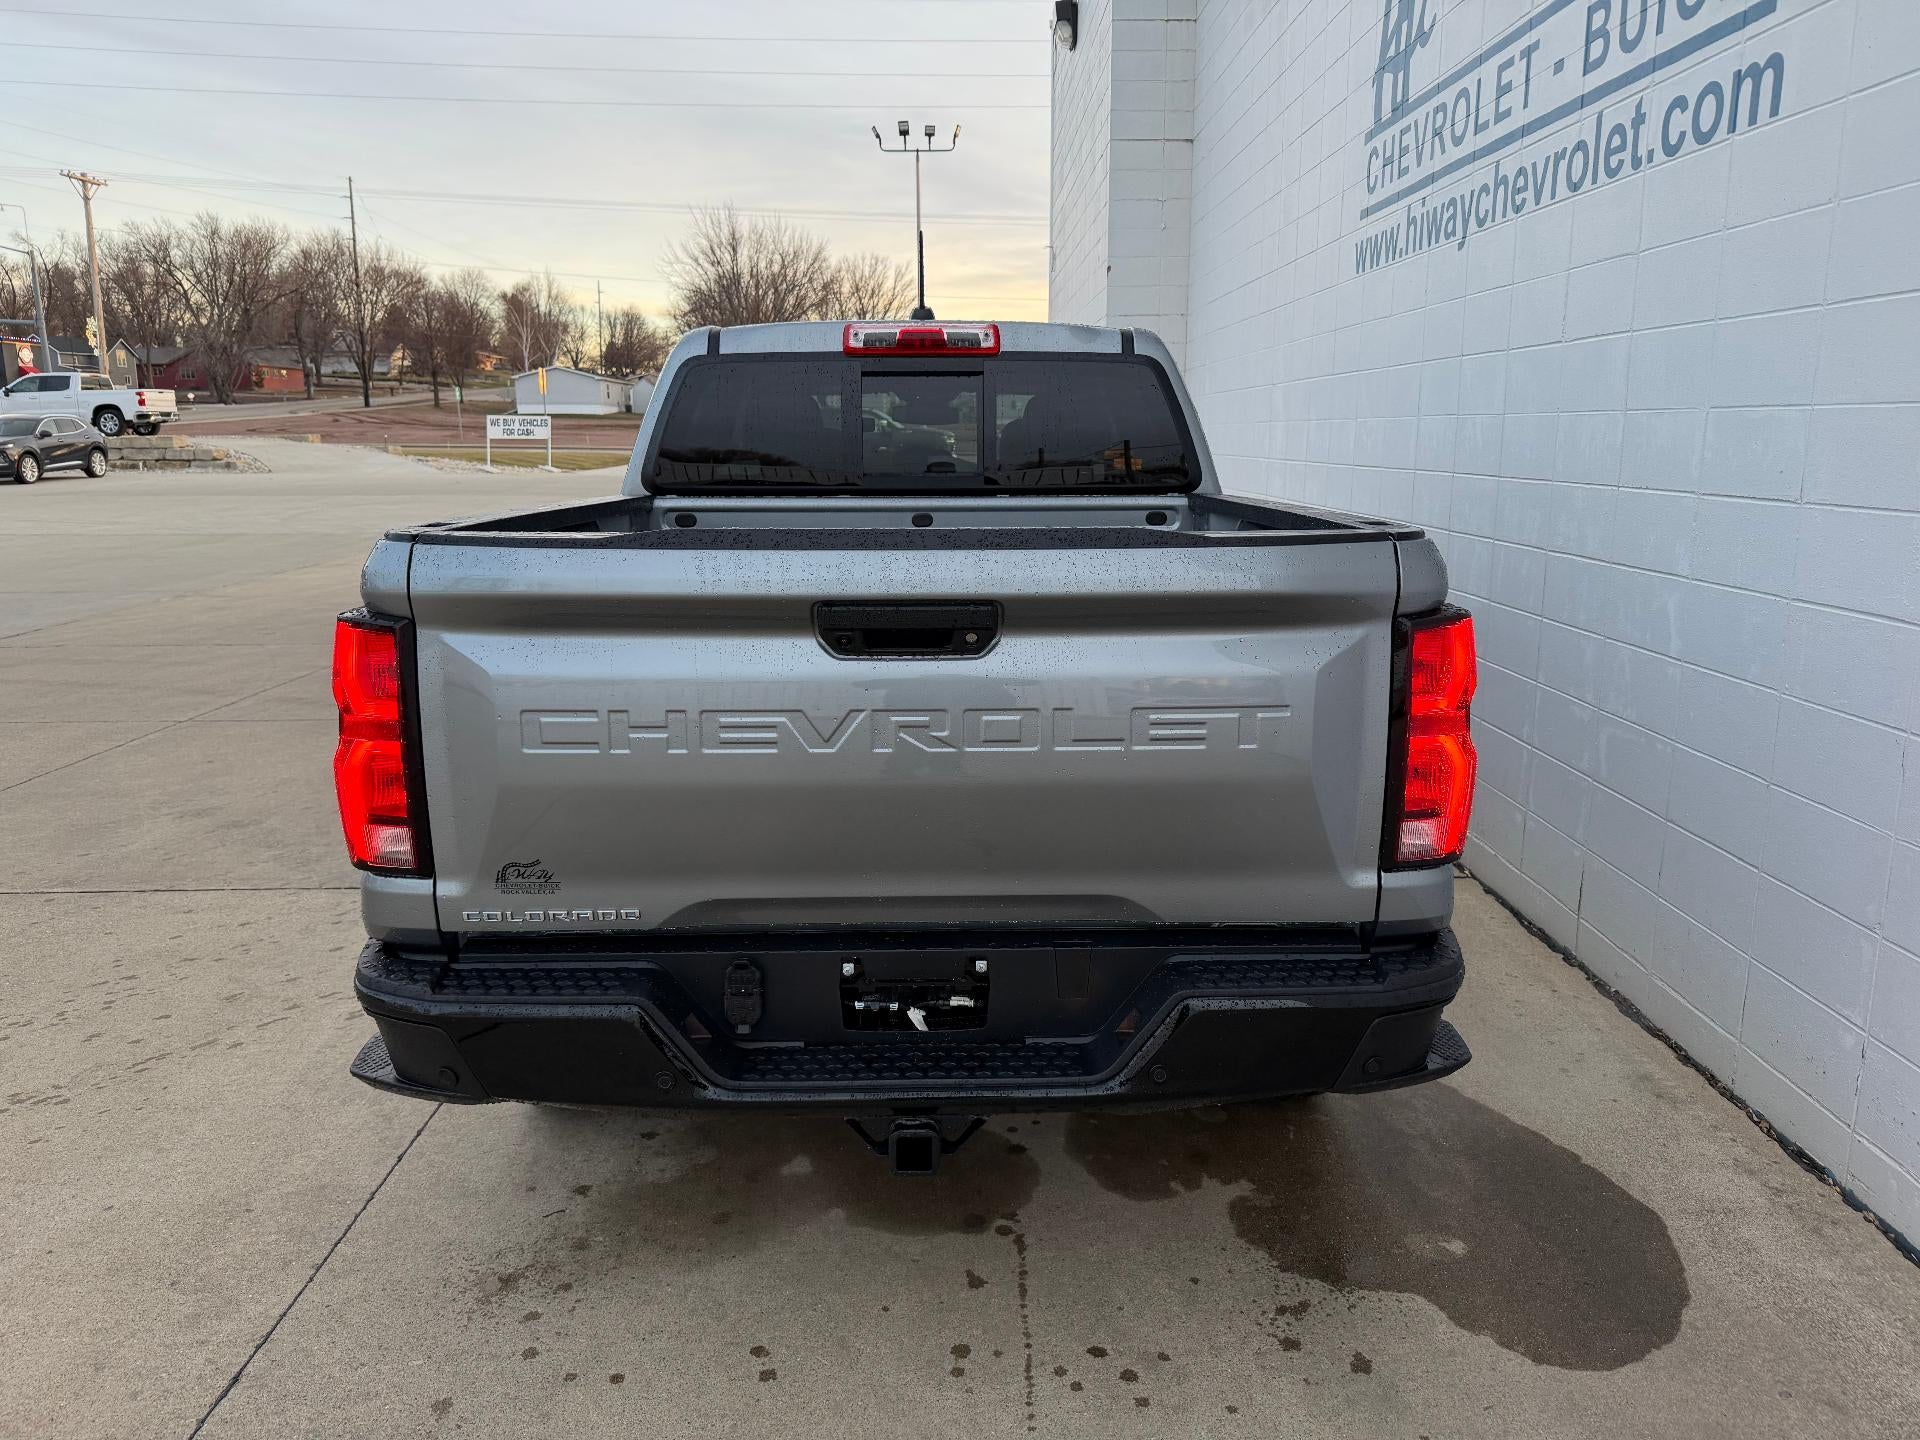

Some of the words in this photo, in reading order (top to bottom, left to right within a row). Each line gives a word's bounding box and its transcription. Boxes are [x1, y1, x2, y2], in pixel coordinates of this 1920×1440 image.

[1366, 39, 1540, 195] CHEVROLET
[1355, 51, 1785, 275] www.hiwaychevrolet.com
[489, 418, 501, 427] WE
[502, 418, 516, 427] BUY
[518, 418, 549, 427] VEHICLES
[502, 428, 515, 437] FOR
[519, 704, 1291, 753] CHEVROLET
[462, 909, 641, 922] COLORADO
